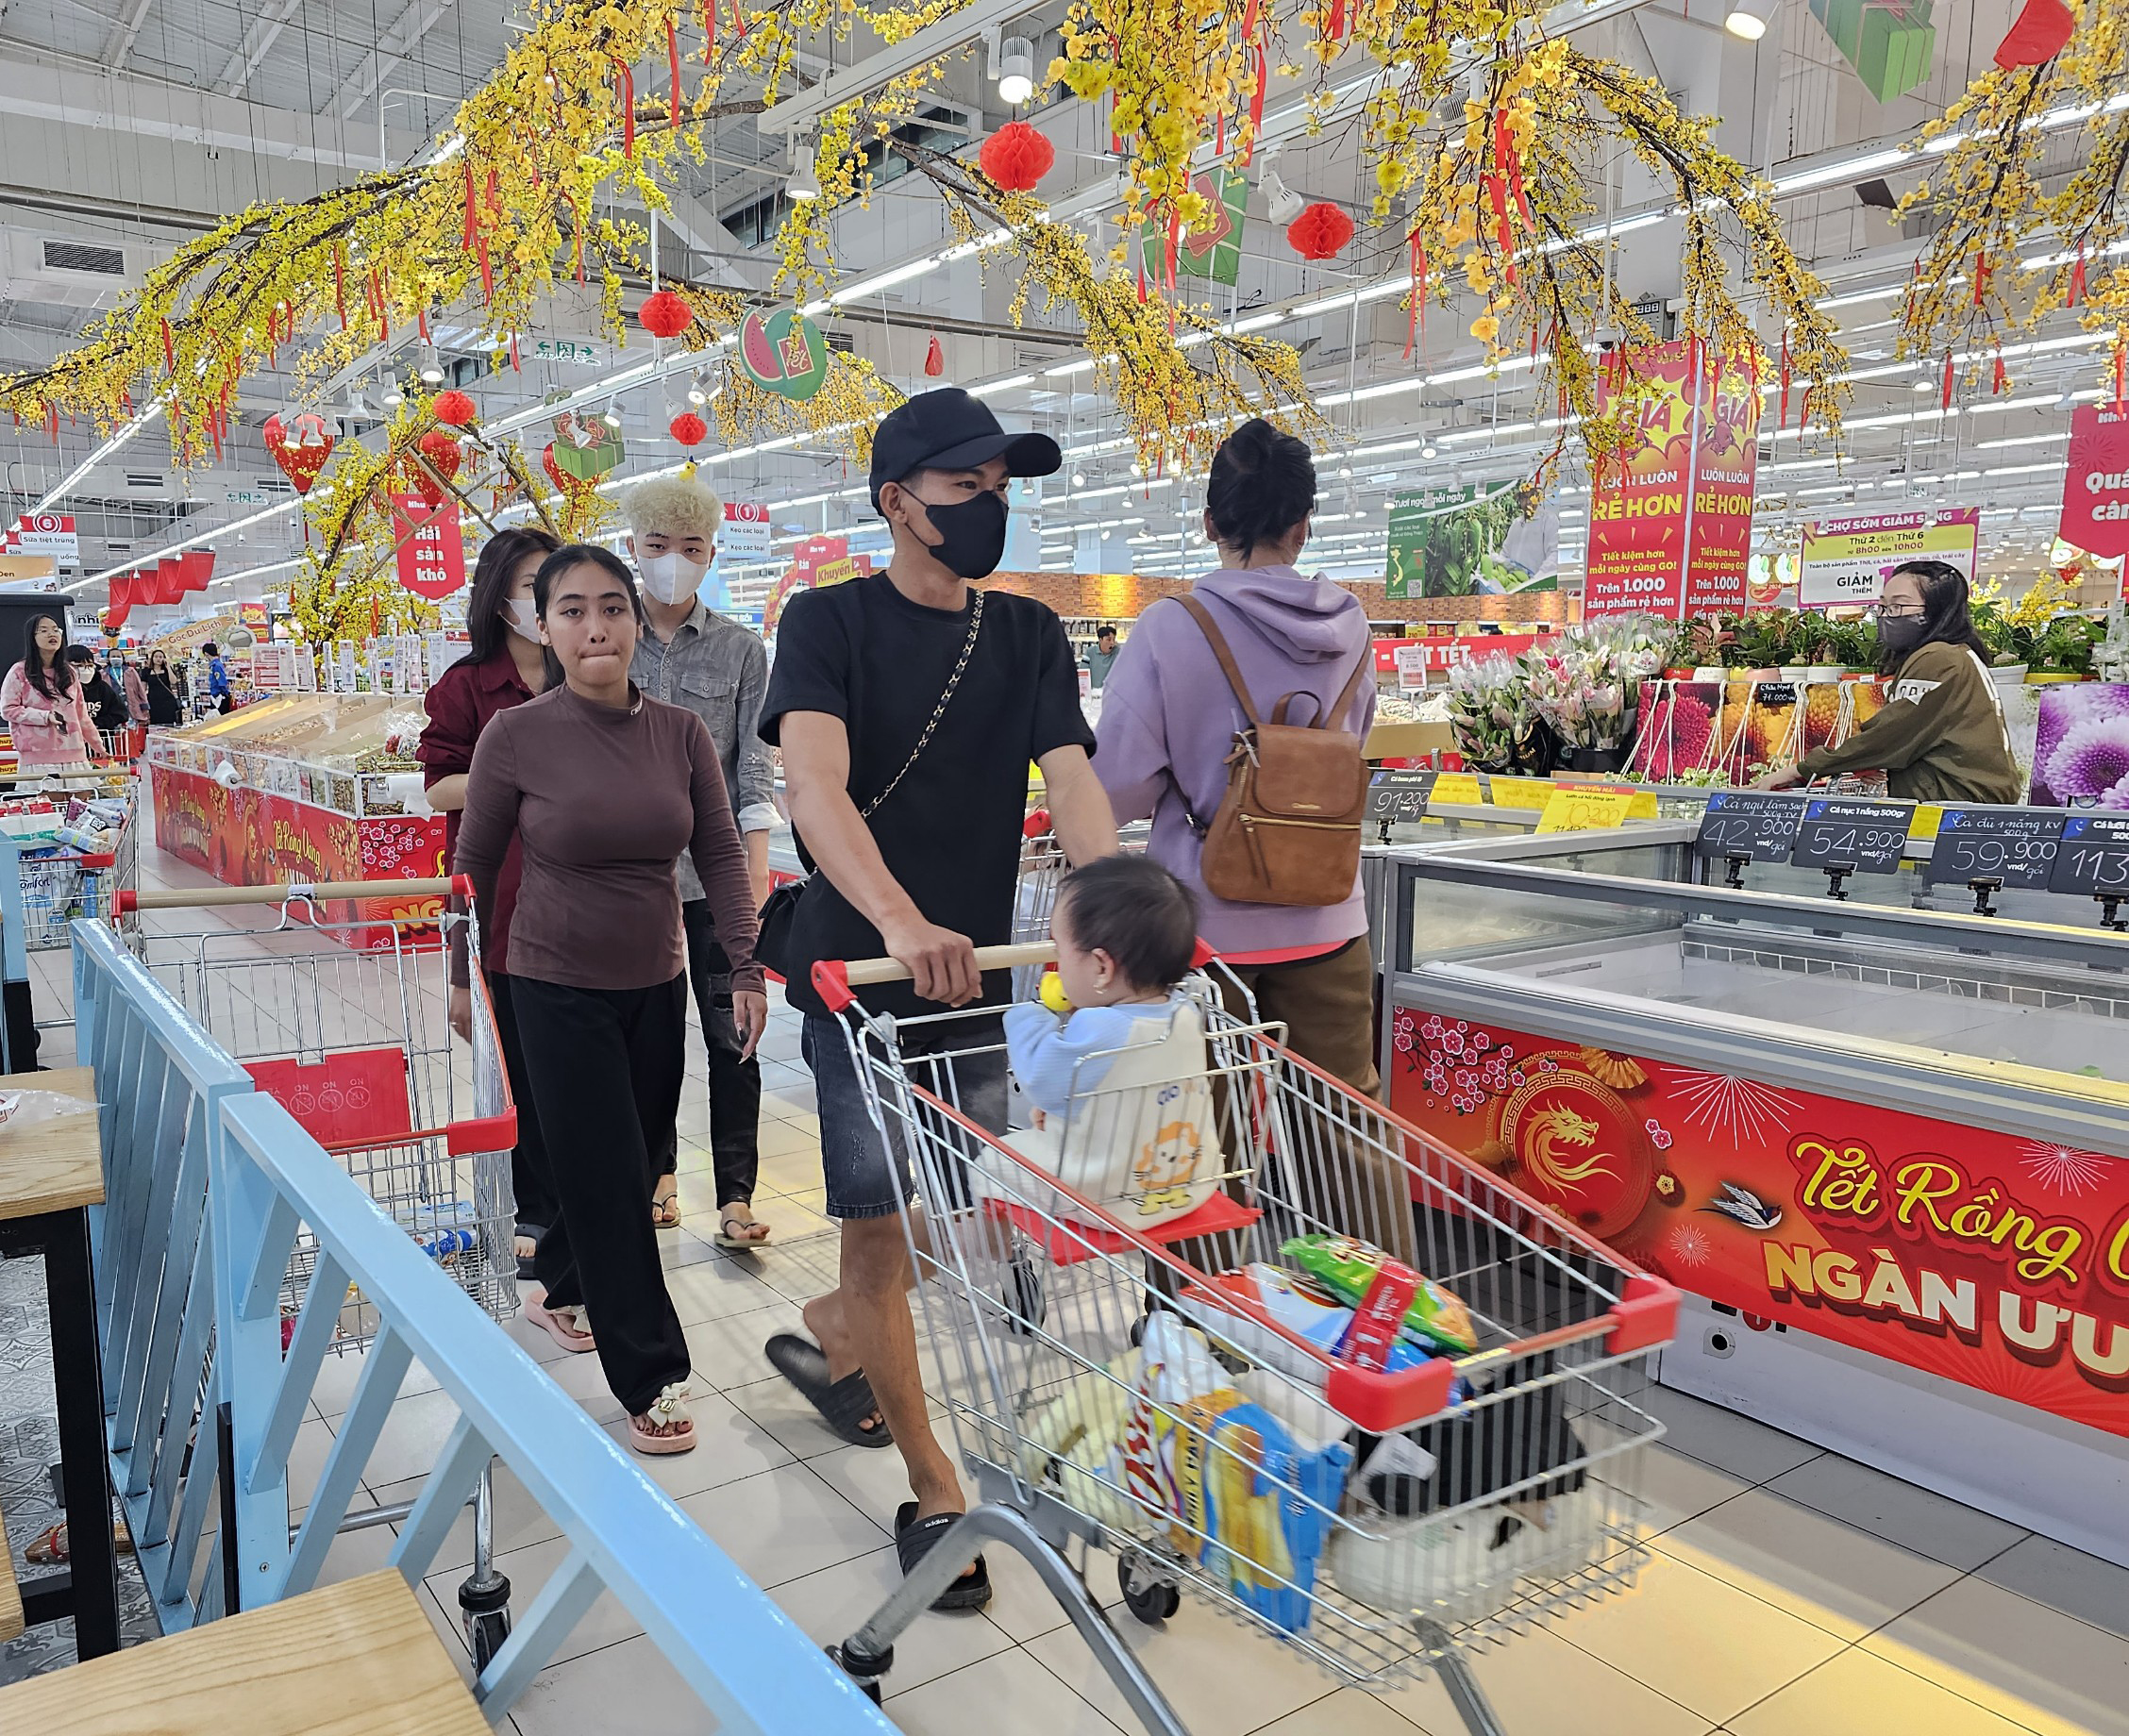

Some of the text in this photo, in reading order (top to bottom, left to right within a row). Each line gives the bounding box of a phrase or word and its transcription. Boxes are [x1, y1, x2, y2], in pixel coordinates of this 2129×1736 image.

[1640, 469, 1678, 486] LUÔN
[1702, 467, 1750, 484] LUÔN LUÔN
[1447, 492, 1467, 503] ngày
[1695, 486, 1752, 516] RẺ HƠN
[1592, 492, 1683, 521] RẺ HƠN
[42, 519, 53, 529] 6
[1826, 522, 1852, 533] CHỢ
[1852, 516, 1880, 530] SỚM
[1882, 512, 1916, 528] GIẢM
[415, 526, 441, 541] Hải
[1850, 535, 1868, 545] Thứ
[1877, 531, 1894, 543] đến
[1897, 530, 1915, 542] Thứ
[1917, 531, 1924, 540] 6
[416, 545, 444, 560] sản
[1601, 549, 1665, 561] Tiết kiệm hơn
[1701, 546, 1740, 557] Tiết kiệm hơn
[1855, 546, 1880, 555] 8h00
[1894, 542, 1924, 552] 10h00
[817, 560, 850, 583] Khuyến
[1589, 560, 1677, 575] mỗi ngày cùng GO!
[1691, 559, 1747, 571] mỗi ngày cùng GO!
[416, 567, 447, 581] khô
[1836, 571, 1873, 587] GIẢM
[1596, 576, 1666, 593] Trên 1.000
[1696, 576, 1740, 590] Trên 1.000
[1852, 586, 1872, 594] THÊM
[1587, 594, 1675, 610] sản phẩm rẻ hơn
[1688, 592, 1744, 607] sản phẩm rẻ hơn
[186, 628, 200, 638] Du
[1437, 638, 1471, 665] TẾT
[1573, 784, 1602, 793] KHUYẾN
[1829, 806, 1840, 815] Cá
[1840, 807, 1854, 817] nục
[1860, 806, 1880, 819] nắng
[1881, 809, 1905, 819] 500gr
[1703, 818, 1795, 847] 42.900
[1809, 826, 1905, 855] 54.900
[1952, 841, 2057, 871] 59.900
[1794, 1141, 1881, 1215] Tết
[1895, 1161, 2084, 1284] Rồng
[1763, 1240, 1978, 1332] NGÀN
